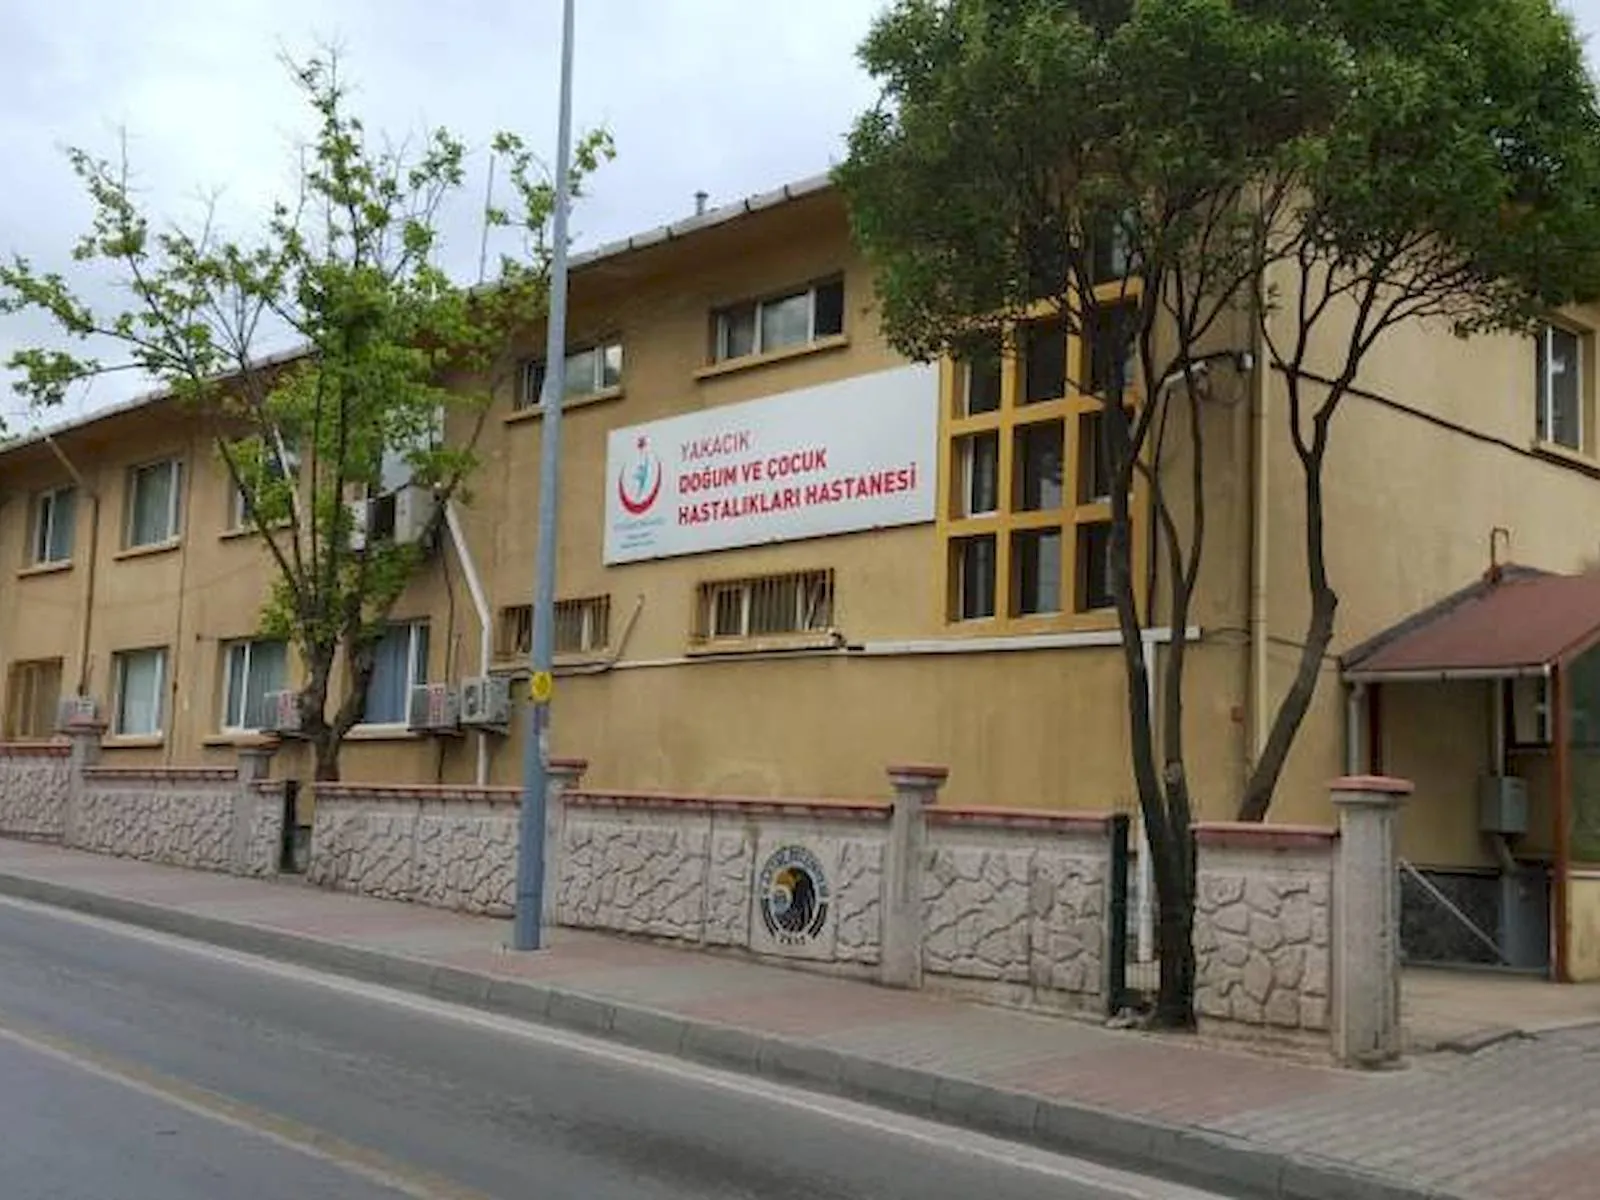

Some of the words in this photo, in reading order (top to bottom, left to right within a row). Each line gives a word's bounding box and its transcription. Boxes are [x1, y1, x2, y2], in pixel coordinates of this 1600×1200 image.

[680, 431, 751, 461] YAKACIK
[678, 465, 737, 494] DOĞUM
[741, 462, 762, 483] VE
[766, 449, 827, 478] ÇOCUK
[678, 488, 801, 525] HASTALIKLARI
[805, 462, 917, 505] HASTANESİ
